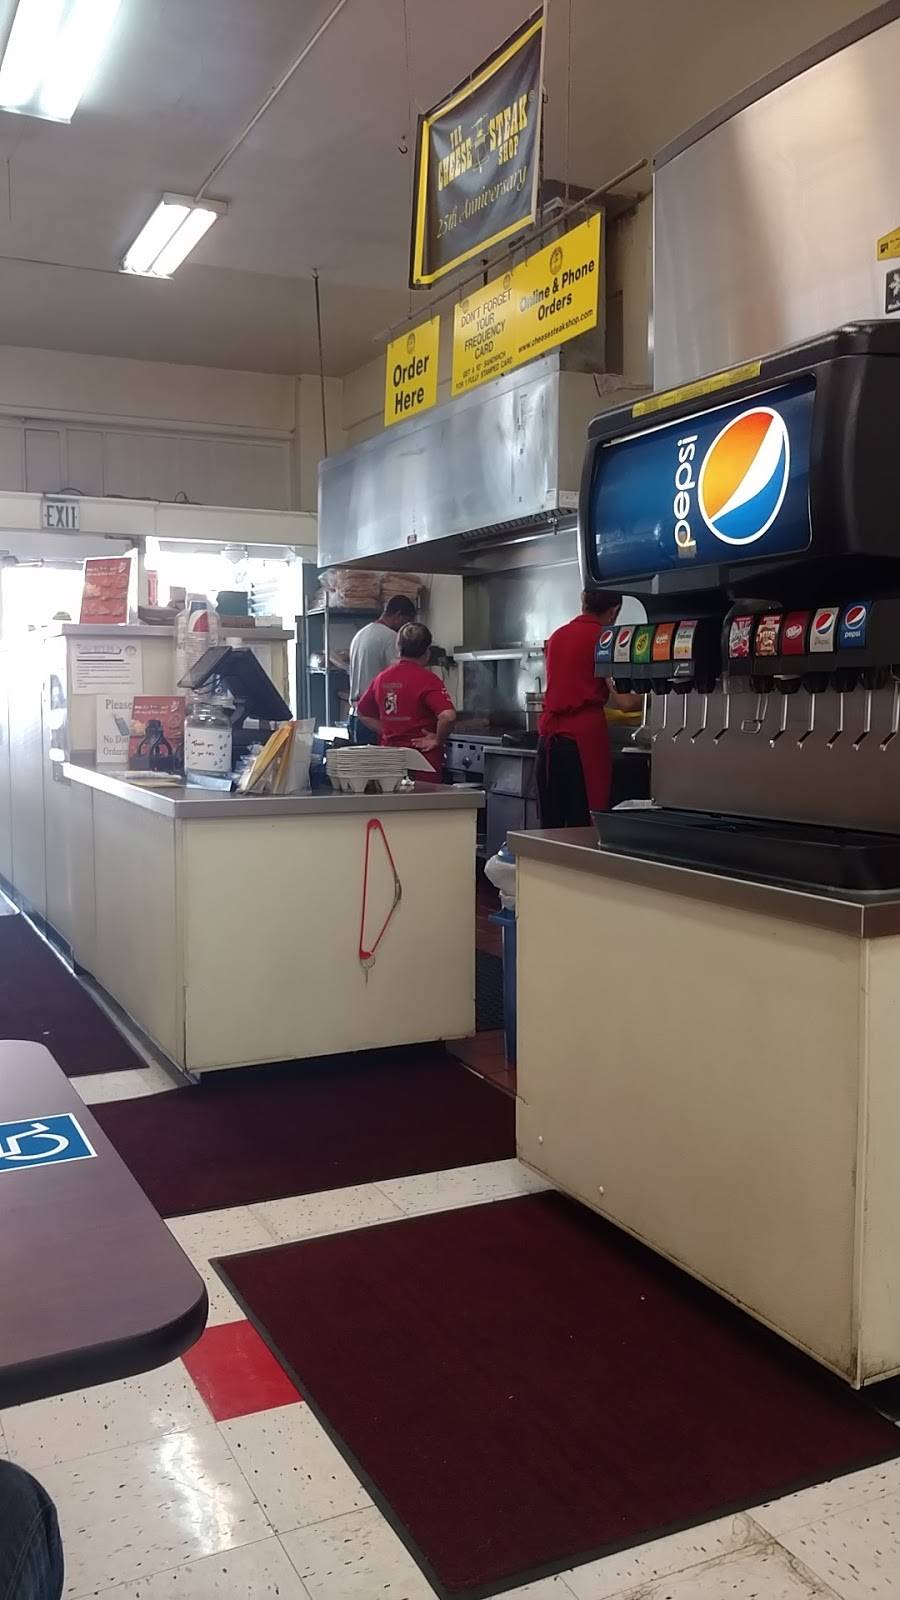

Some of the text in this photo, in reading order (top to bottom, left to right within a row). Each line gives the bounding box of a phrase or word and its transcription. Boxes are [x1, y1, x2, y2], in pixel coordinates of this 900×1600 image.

[438, 94, 528, 191] CHEESE STEAK
[498, 135, 519, 165] SHOP
[437, 166, 527, 239] 25th Anniversary
[519, 259, 595, 313] Online & Phone
[460, 288, 512, 328] DON'T FORGET
[476, 313, 495, 331] YOUR
[537, 292, 573, 321] Orders
[464, 320, 505, 352] FREQUENCY
[518, 309, 594, 353] www.cheesesteakshop.com
[474, 341, 494, 359] CARD
[393, 354, 429, 387] Order
[394, 386, 424, 415] Here
[673, 434, 698, 547] pepsi
[47, 504, 76, 528] EXIT
[844, 631, 861, 639] pepsi
[105, 699, 132, 710] Please
